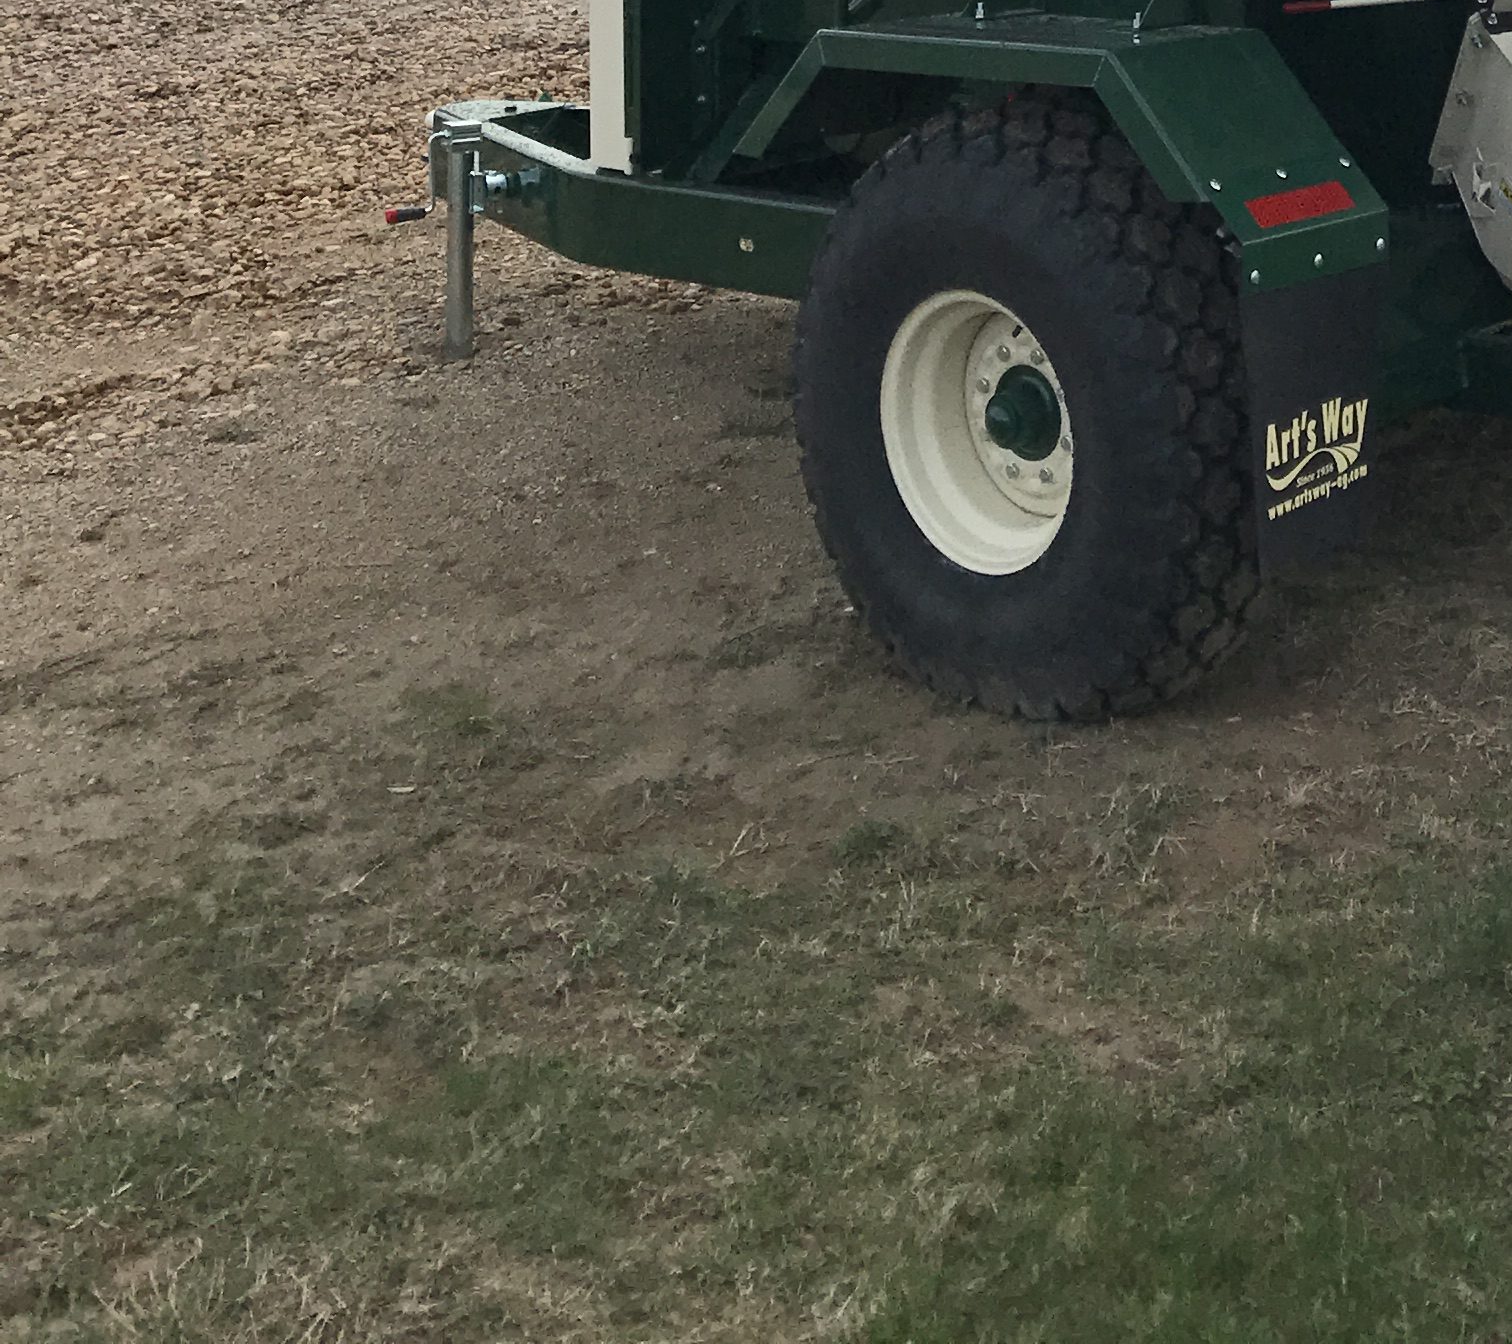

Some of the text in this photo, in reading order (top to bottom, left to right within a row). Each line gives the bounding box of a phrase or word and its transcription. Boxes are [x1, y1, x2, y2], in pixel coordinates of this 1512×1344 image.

[1266, 397, 1368, 470] Art's Way
[1267, 464, 1368, 520] www.artsway-ag.com
